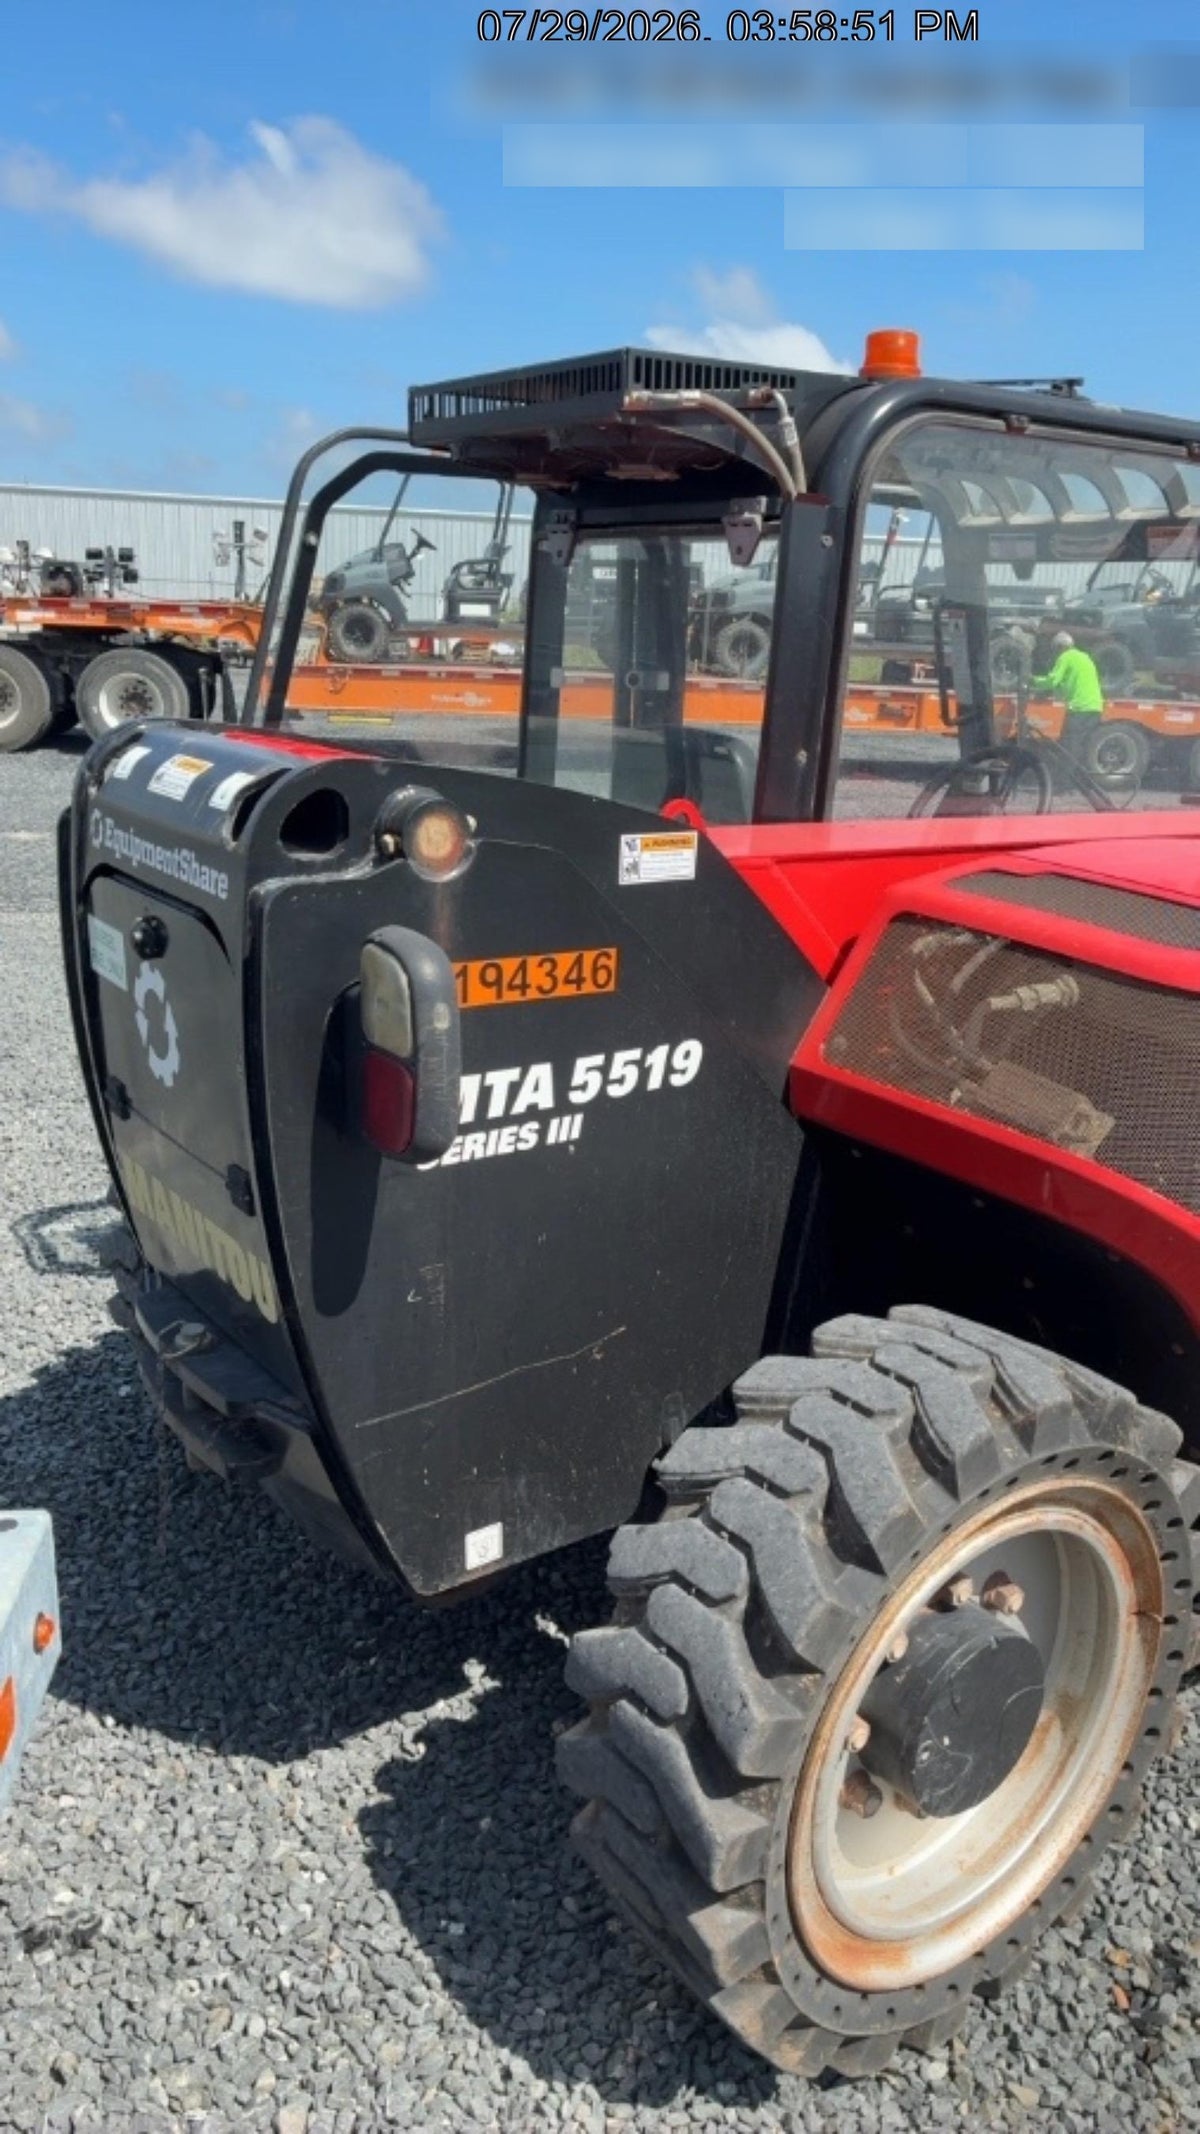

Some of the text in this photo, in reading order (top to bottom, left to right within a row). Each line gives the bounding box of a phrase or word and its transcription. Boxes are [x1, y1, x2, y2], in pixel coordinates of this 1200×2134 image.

[104, 816, 230, 900] EquipmentShare
[455, 950, 613, 1004] 194346
[568, 1038, 704, 1104] 5519
[416, 1112, 585, 1171] ERIES III
[120, 1149, 279, 1324] MANITOU
